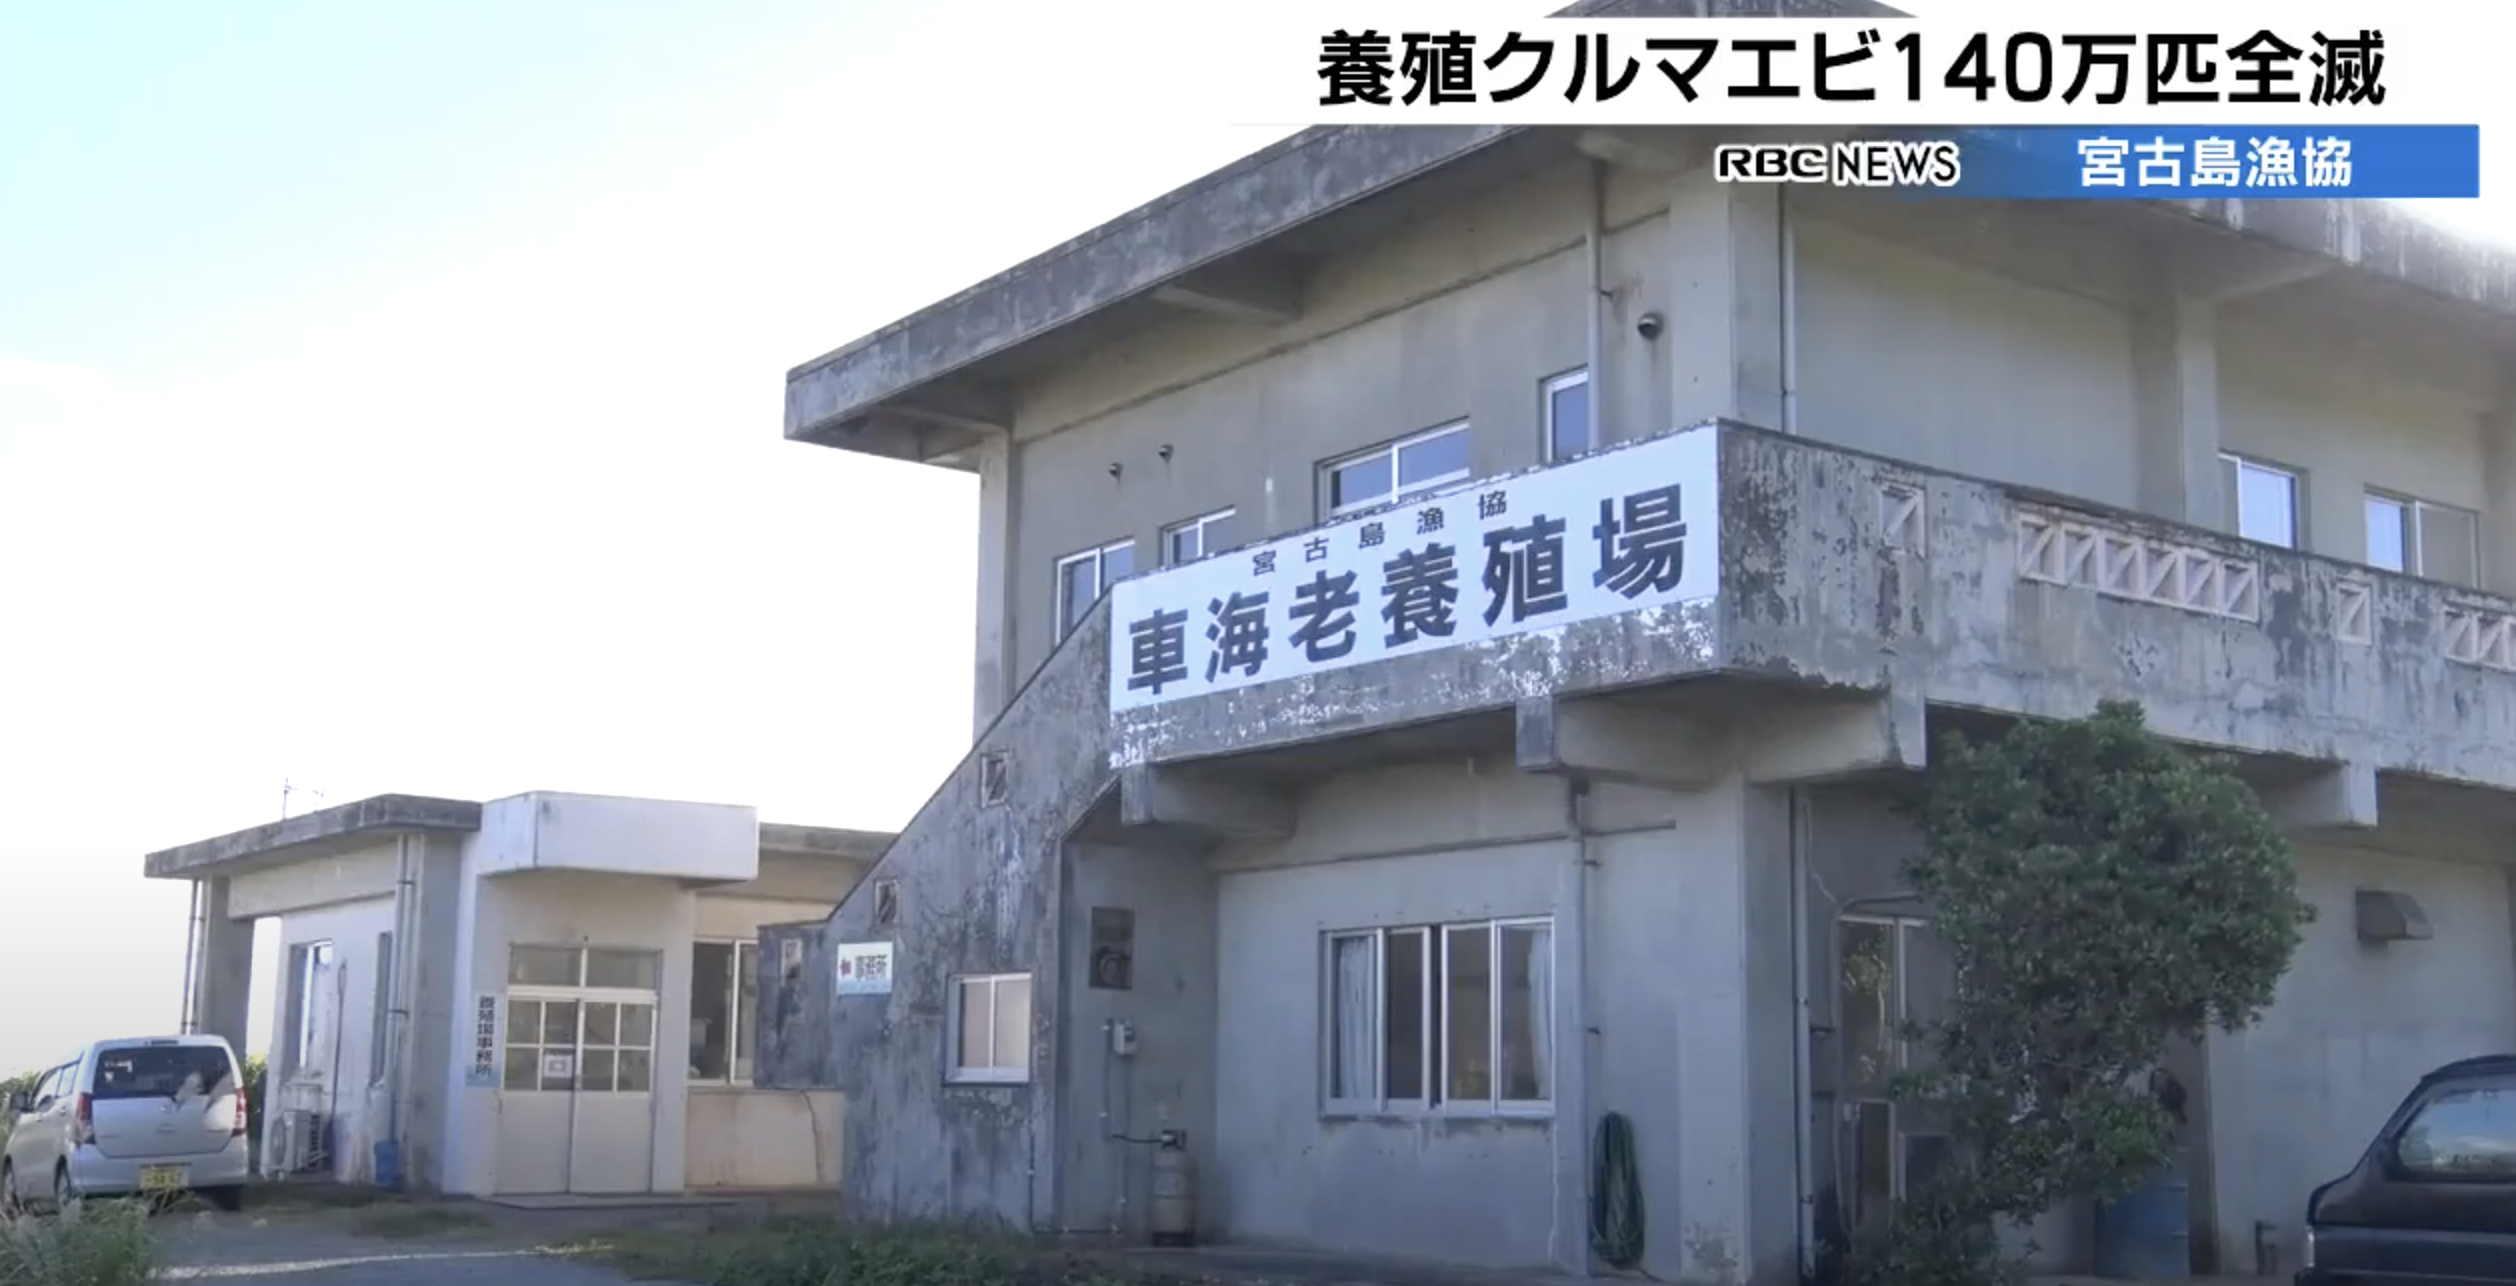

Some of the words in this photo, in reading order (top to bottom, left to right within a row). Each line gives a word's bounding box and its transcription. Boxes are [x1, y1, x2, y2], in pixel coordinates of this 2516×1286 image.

[1127, 484, 1687, 695] 車海老養殖場
[1252, 490, 1508, 577] 宮古島漁協
